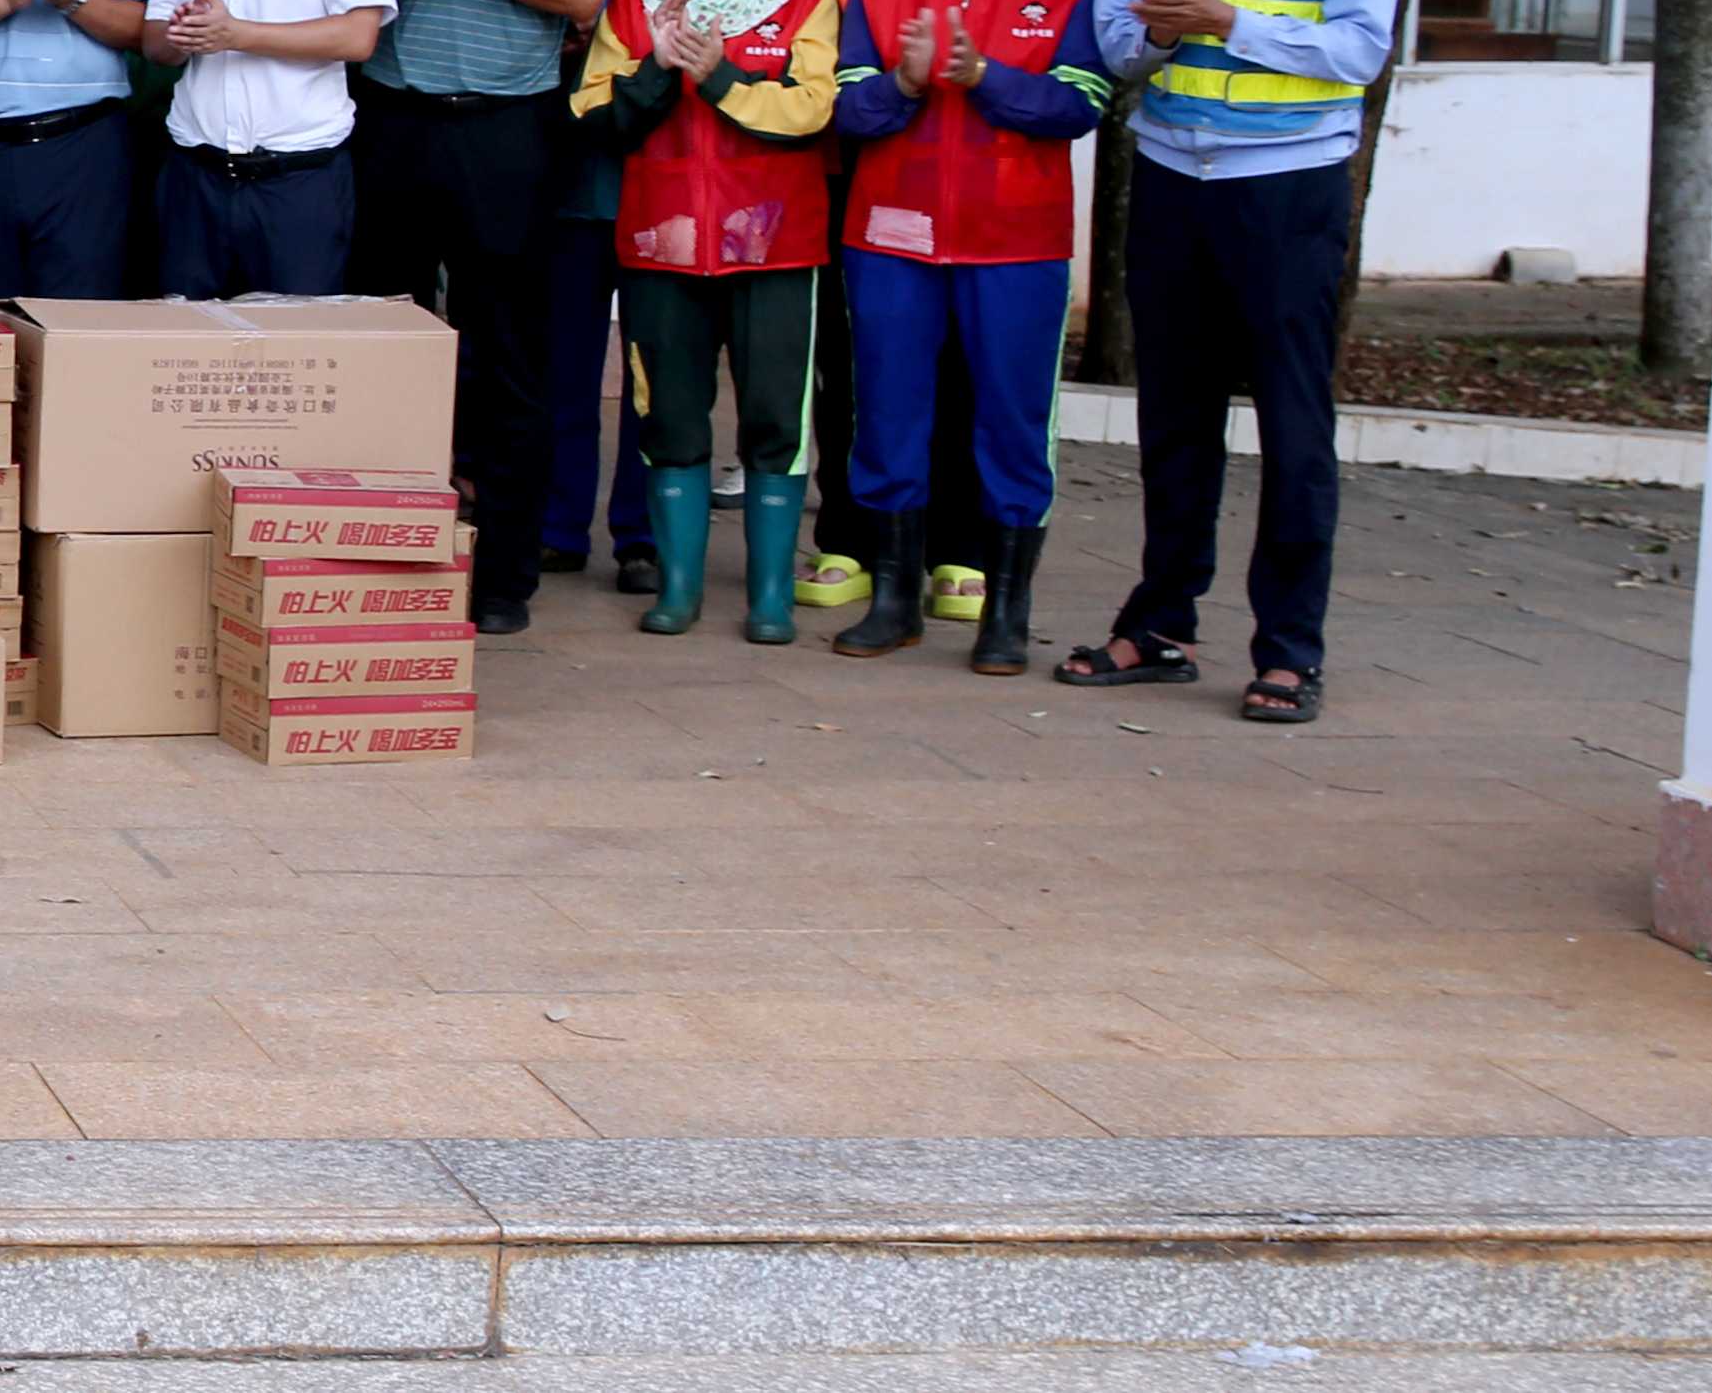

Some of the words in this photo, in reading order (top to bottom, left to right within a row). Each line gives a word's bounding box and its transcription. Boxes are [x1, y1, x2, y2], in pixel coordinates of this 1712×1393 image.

[249, 520, 328, 543] 怕上火
[337, 523, 439, 547] 喝加多宝
[279, 591, 353, 614] 怕上火
[361, 589, 453, 612] 喝加多宝
[283, 660, 357, 683] 怕上火
[365, 658, 458, 681] 喝加多宝
[286, 730, 359, 753] 怕上火
[367, 727, 462, 751] 喝加多宝
